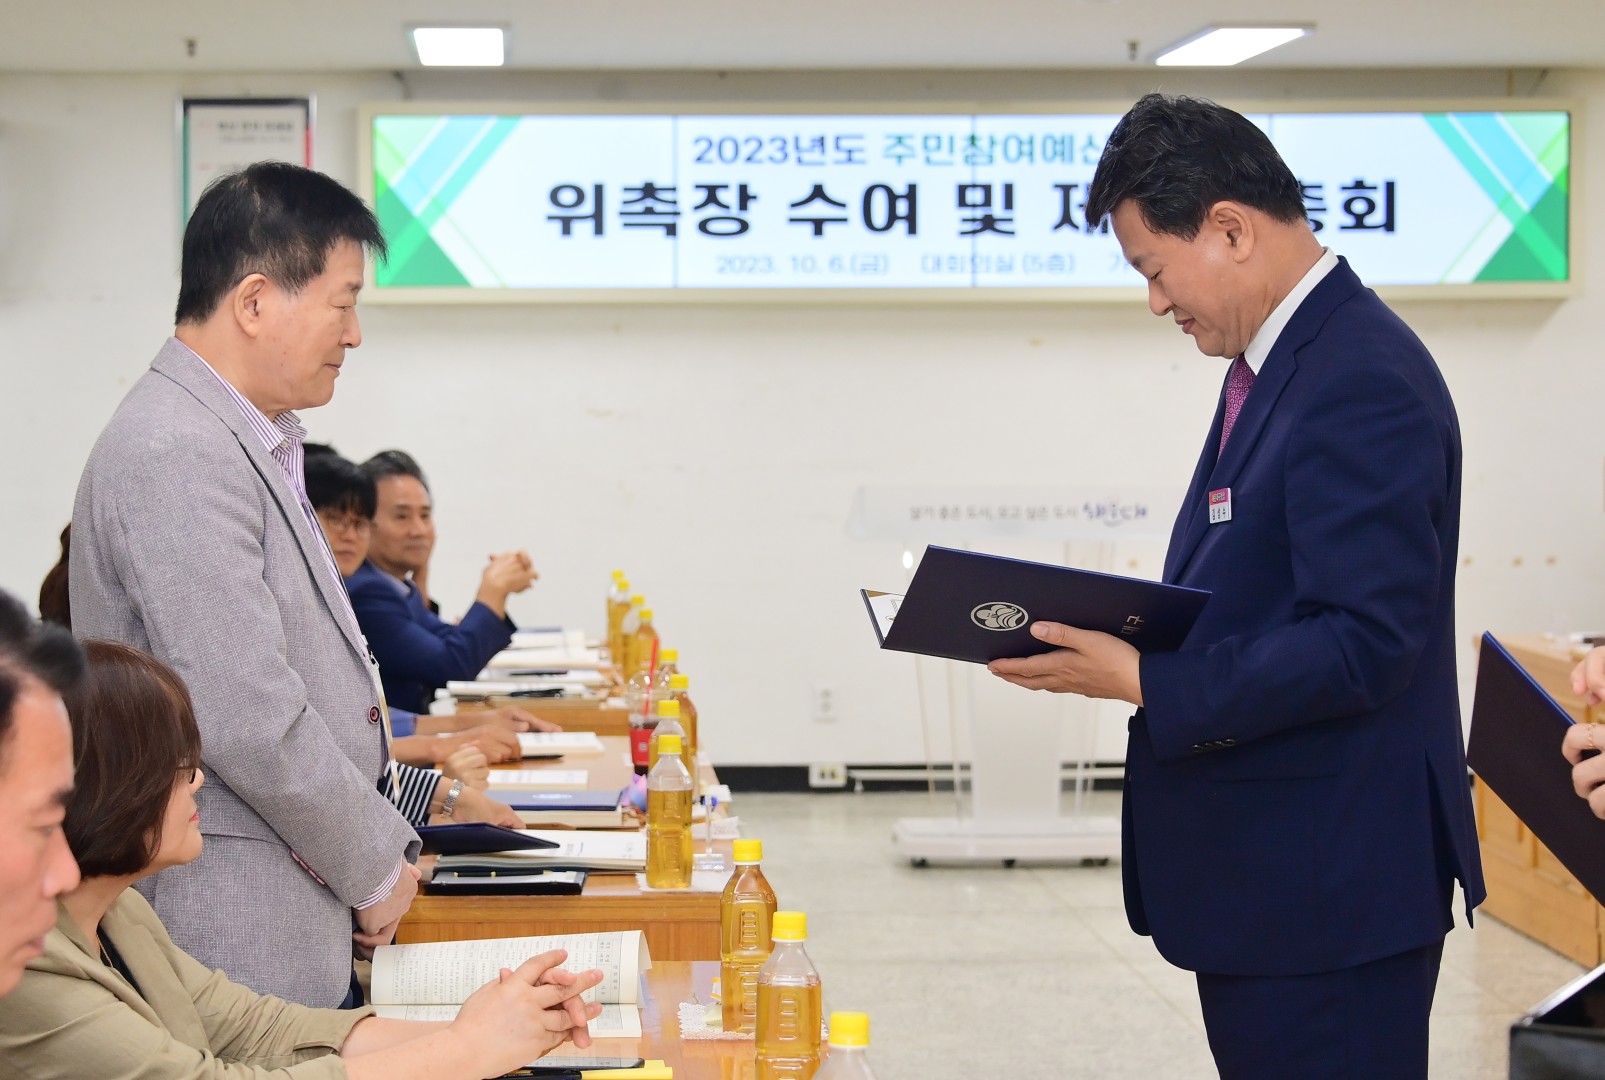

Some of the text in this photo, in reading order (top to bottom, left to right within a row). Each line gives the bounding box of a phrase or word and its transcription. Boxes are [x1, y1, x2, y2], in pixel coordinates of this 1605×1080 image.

[693, 133, 867, 166] 2023년도
[546, 182, 758, 238] 위촉장
[788, 182, 920, 238] 수여
[956, 181, 1017, 237] 및
[716, 253, 780, 274] 2023.
[789, 253, 823, 274] 10.
[921, 252, 1014, 275] 대회의실
[1023, 251, 1076, 276] (5층)
